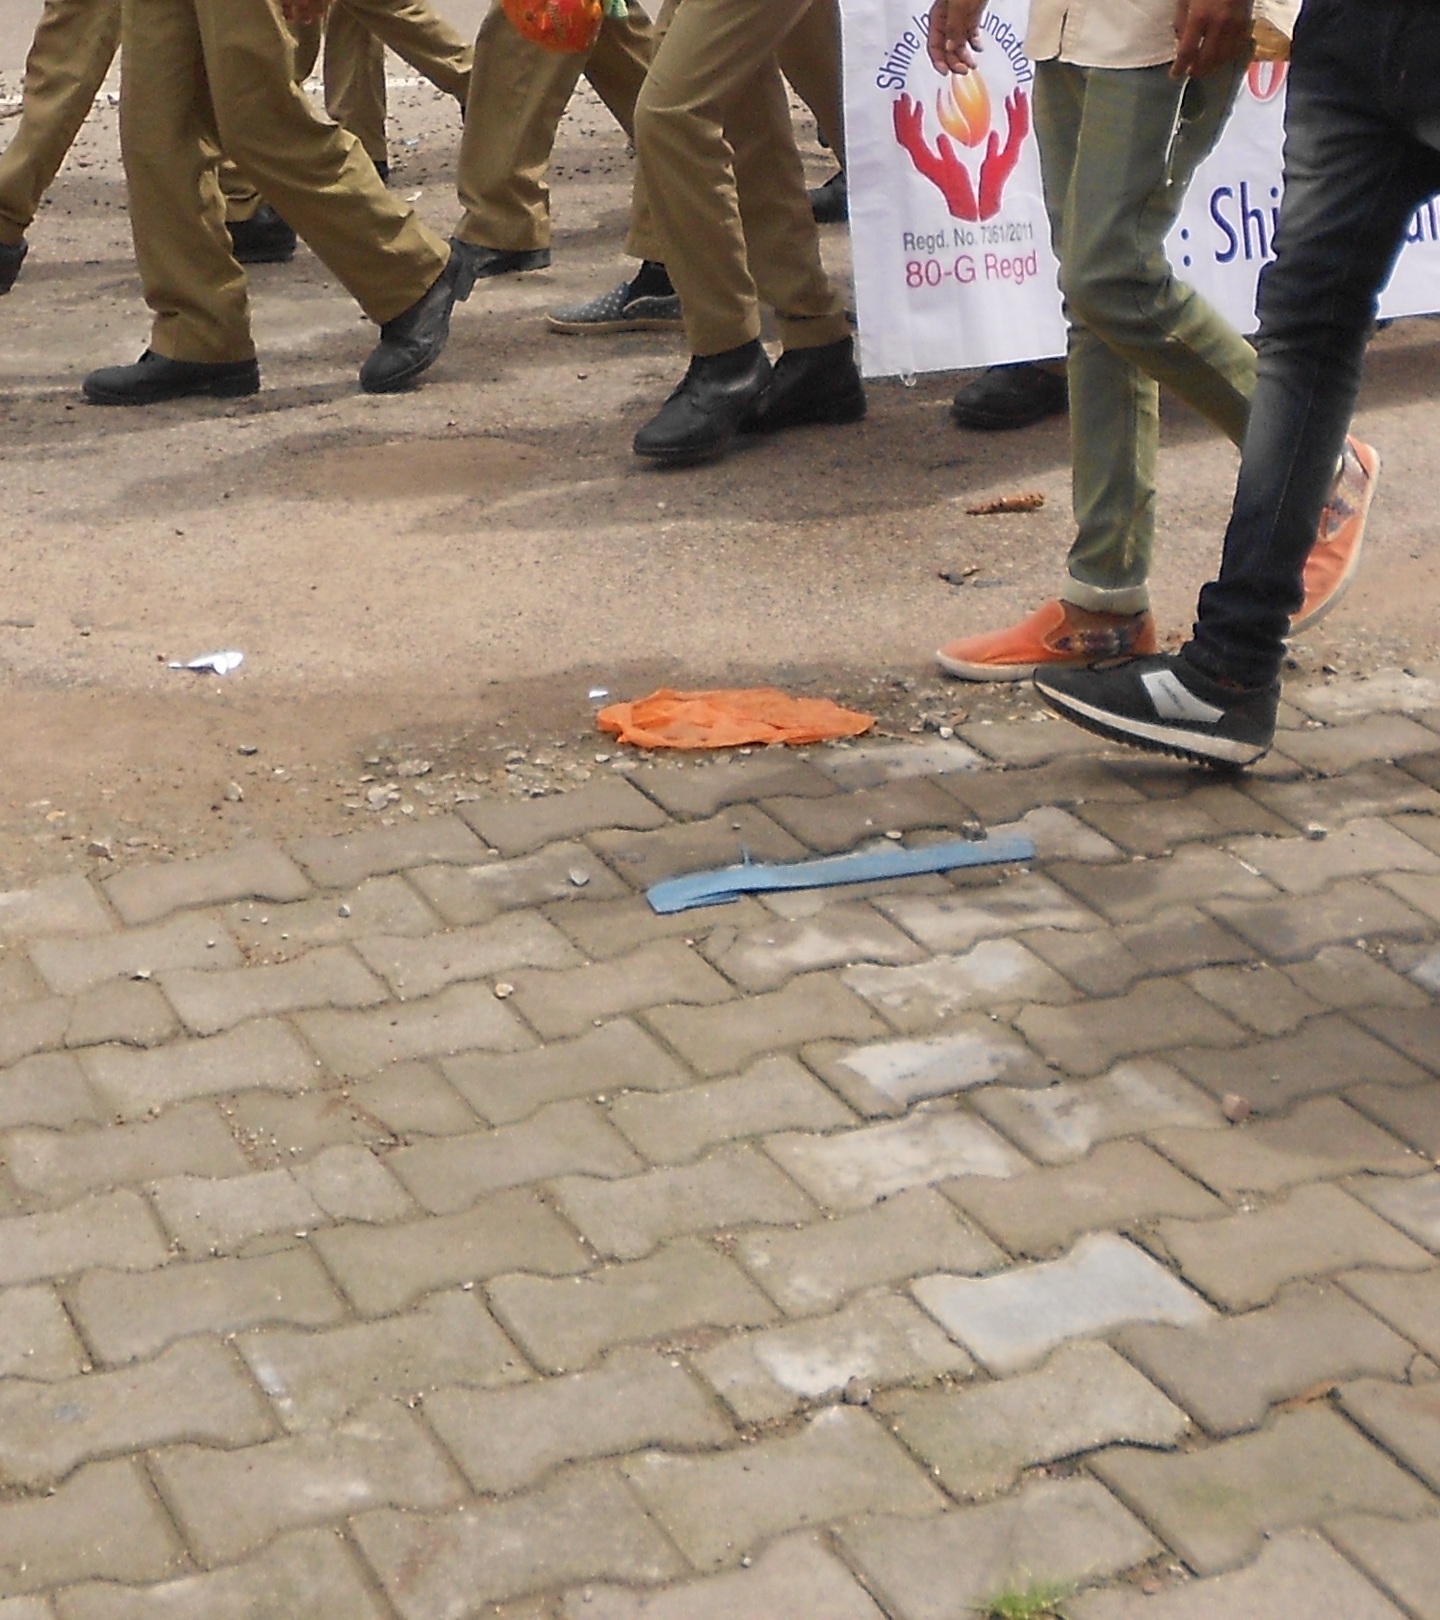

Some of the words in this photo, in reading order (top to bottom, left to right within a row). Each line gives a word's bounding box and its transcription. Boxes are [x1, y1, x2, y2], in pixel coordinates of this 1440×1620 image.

[876, 32, 921, 90] Shine
[980, 12, 1033, 84] undation
[903, 231, 949, 255] Regd.
[954, 228, 978, 248] No.
[1210, 181, 1279, 263] Shi
[906, 255, 976, 288] 80-G
[985, 250, 1038, 285] Regd
